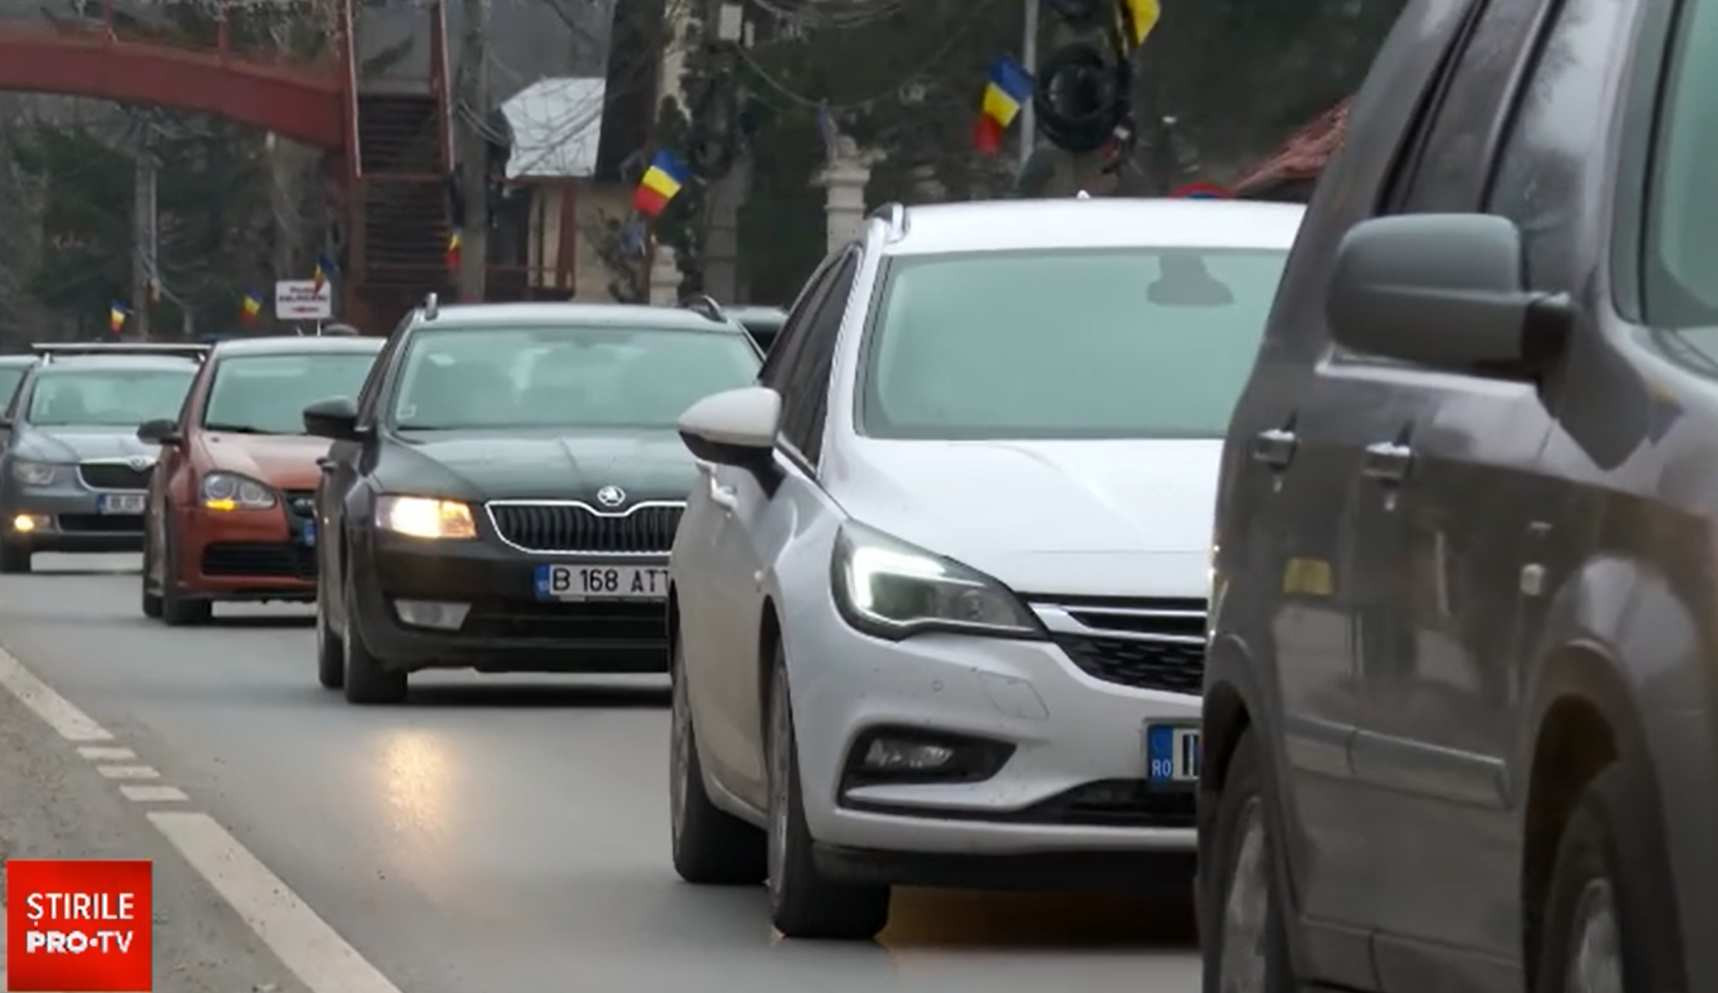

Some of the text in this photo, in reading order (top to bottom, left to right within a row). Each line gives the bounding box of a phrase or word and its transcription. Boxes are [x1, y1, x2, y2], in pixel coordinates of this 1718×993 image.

[552, 568, 571, 591] B
[580, 569, 618, 592] 168
[1151, 759, 1172, 777] RO
